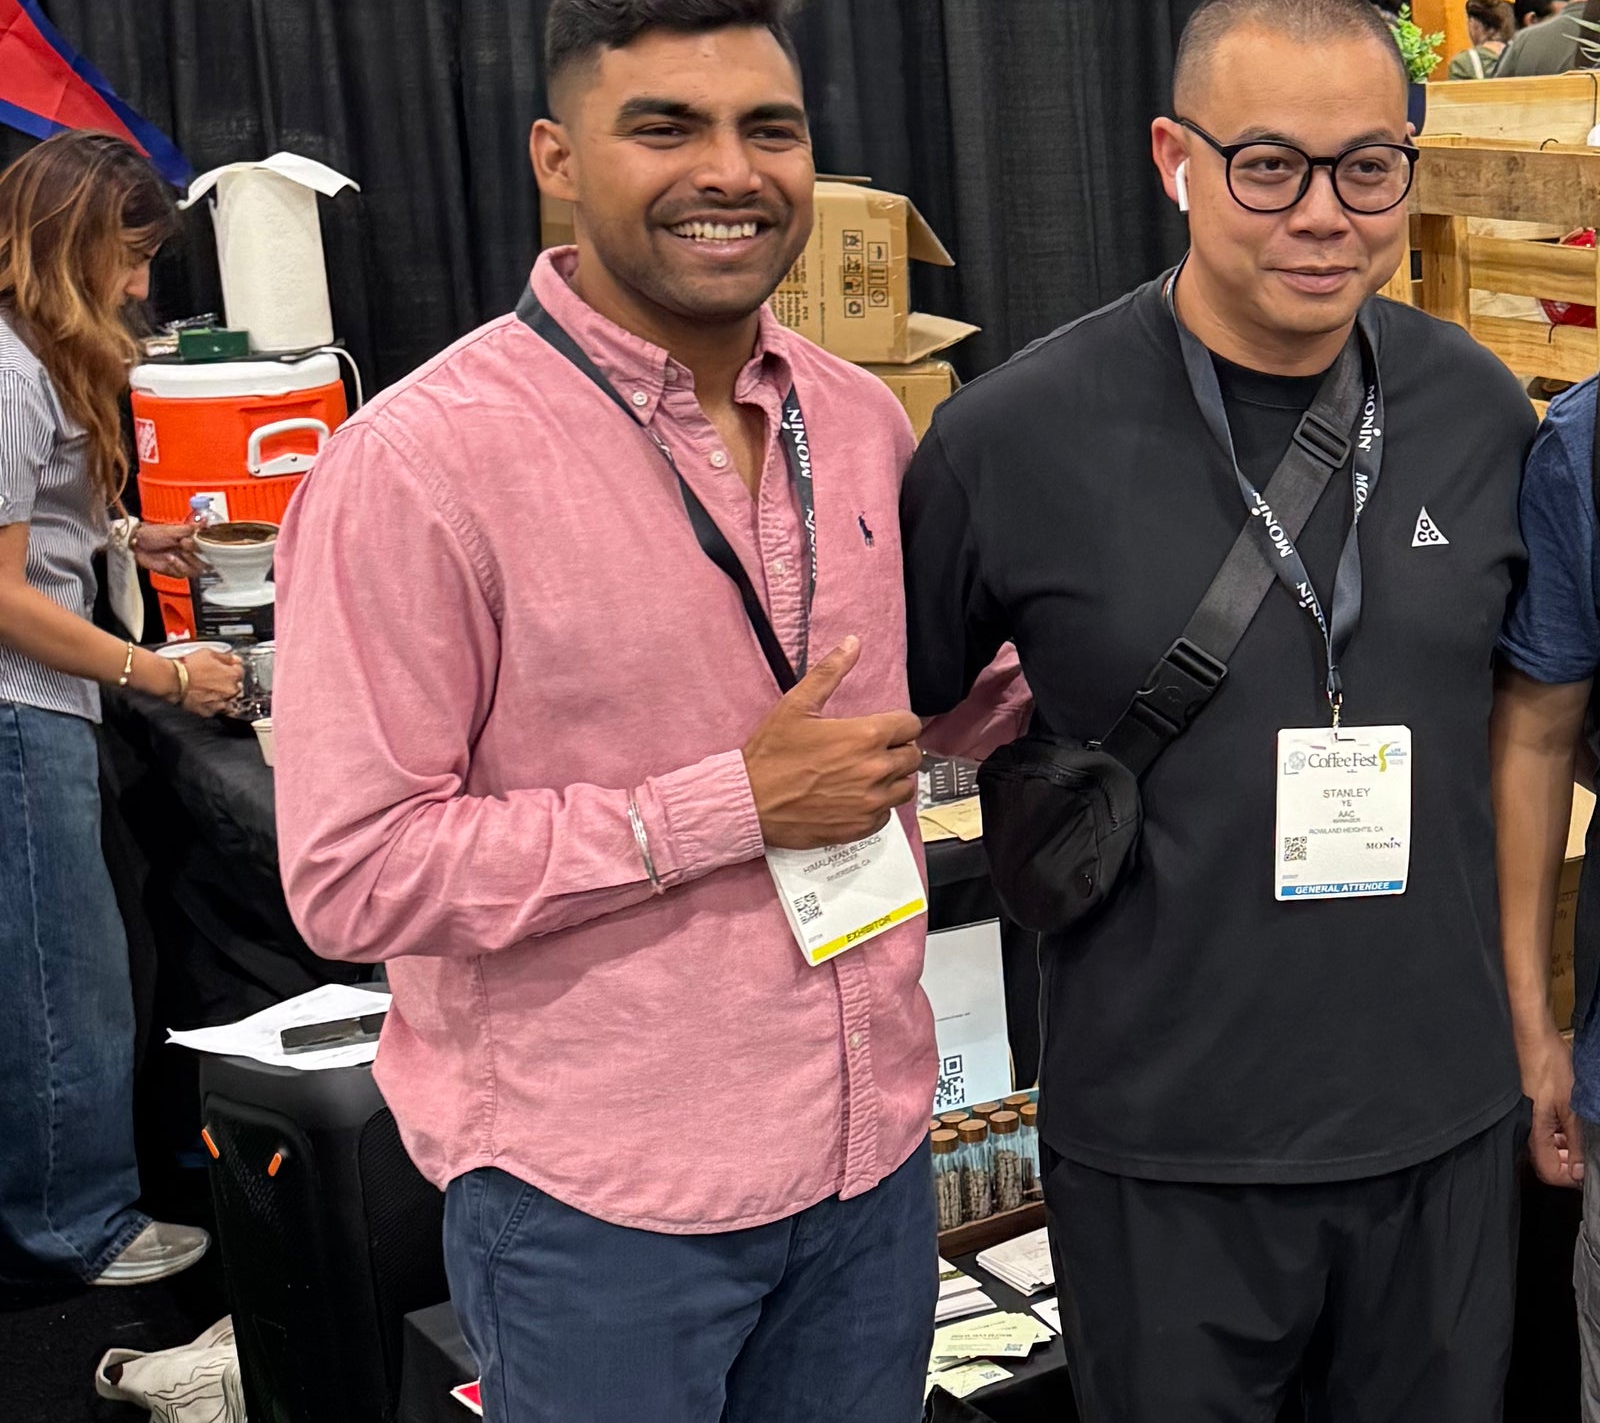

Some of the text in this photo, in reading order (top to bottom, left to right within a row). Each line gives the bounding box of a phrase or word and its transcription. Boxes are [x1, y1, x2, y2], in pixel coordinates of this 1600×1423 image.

[1322, 787, 1371, 799] STANLEY
[1338, 810, 1355, 818] AAC
[803, 835, 882, 874] HIMALAYAN BLENDS
[861, 858, 872, 868] CA
[1295, 882, 1390, 895] GENERAL ATTENDEE
[846, 915, 892, 943] EXHIBITOR
